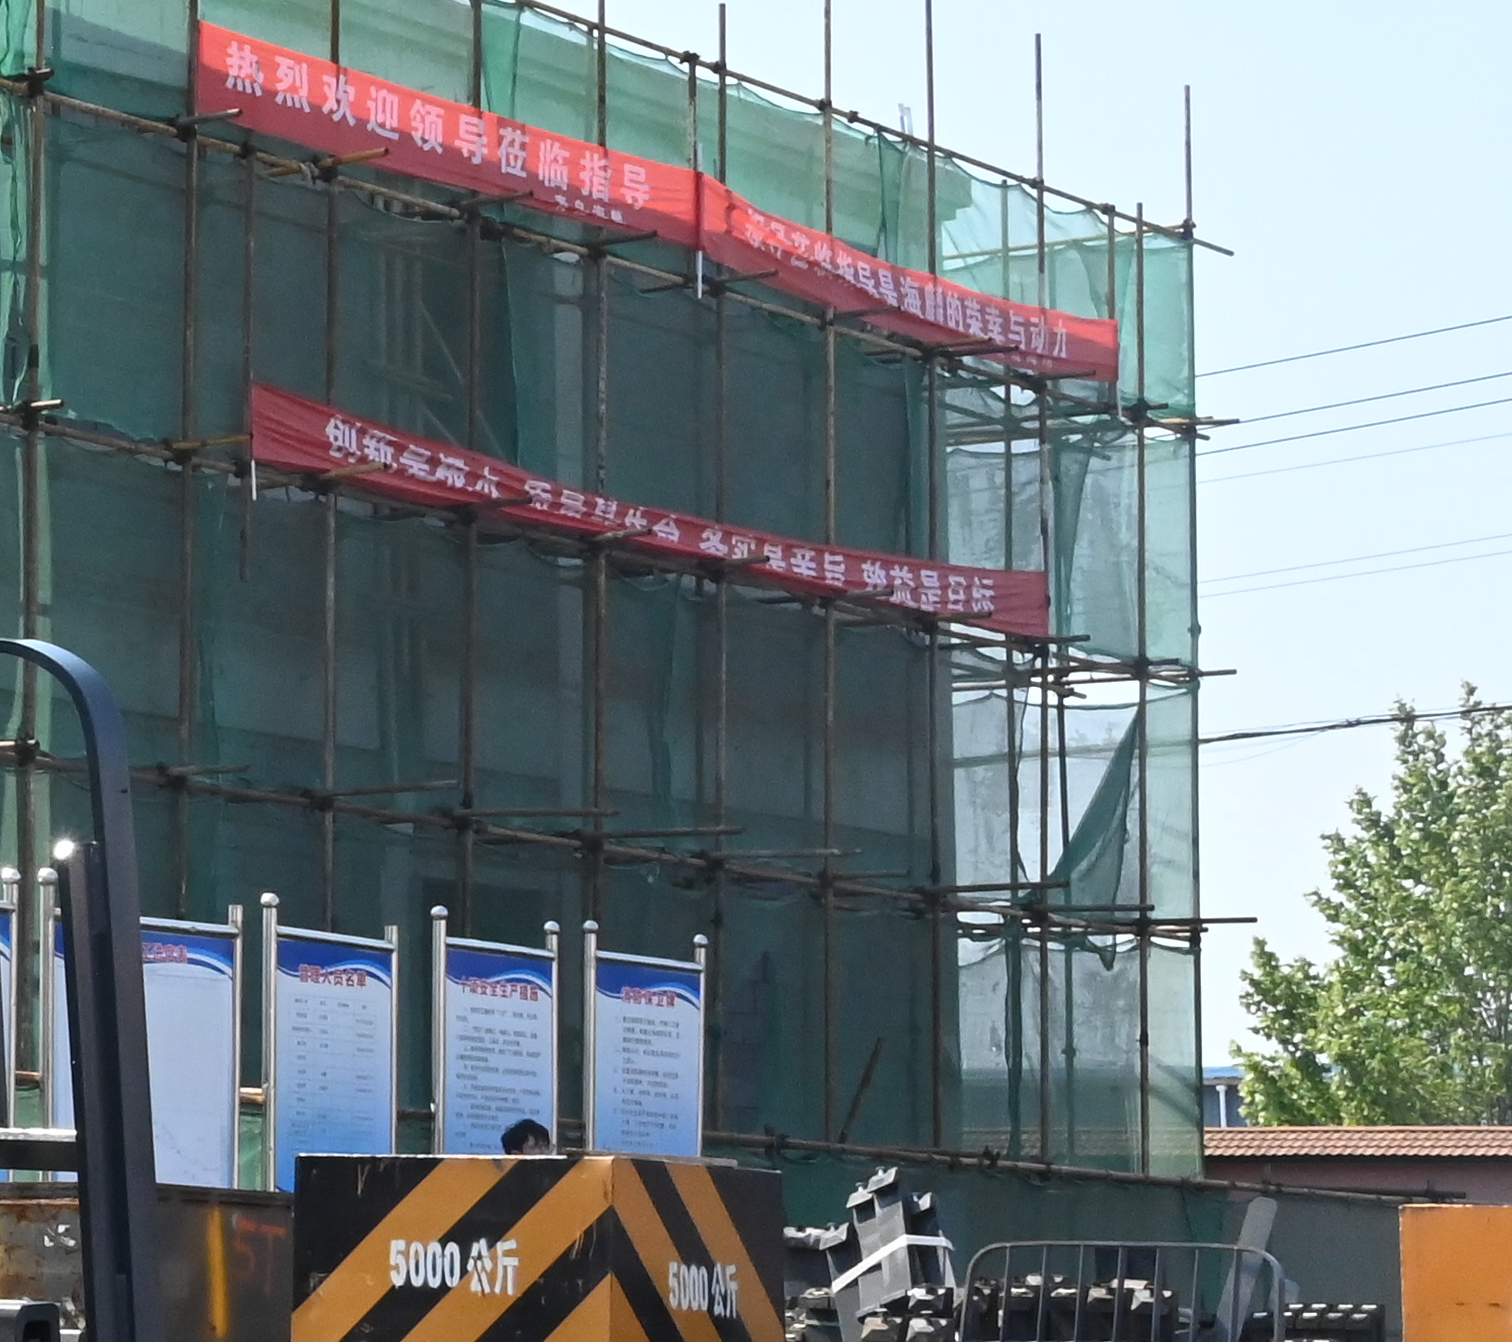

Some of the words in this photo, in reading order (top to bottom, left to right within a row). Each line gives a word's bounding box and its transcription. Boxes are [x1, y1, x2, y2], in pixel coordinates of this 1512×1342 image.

[224, 40, 651, 210] 热烈欢迎领导莅临指导
[389, 1238, 461, 1289] 5000
[466, 1237, 520, 1297] 公斤
[667, 1261, 709, 1312] 5000
[711, 1261, 739, 1319] 公斤
